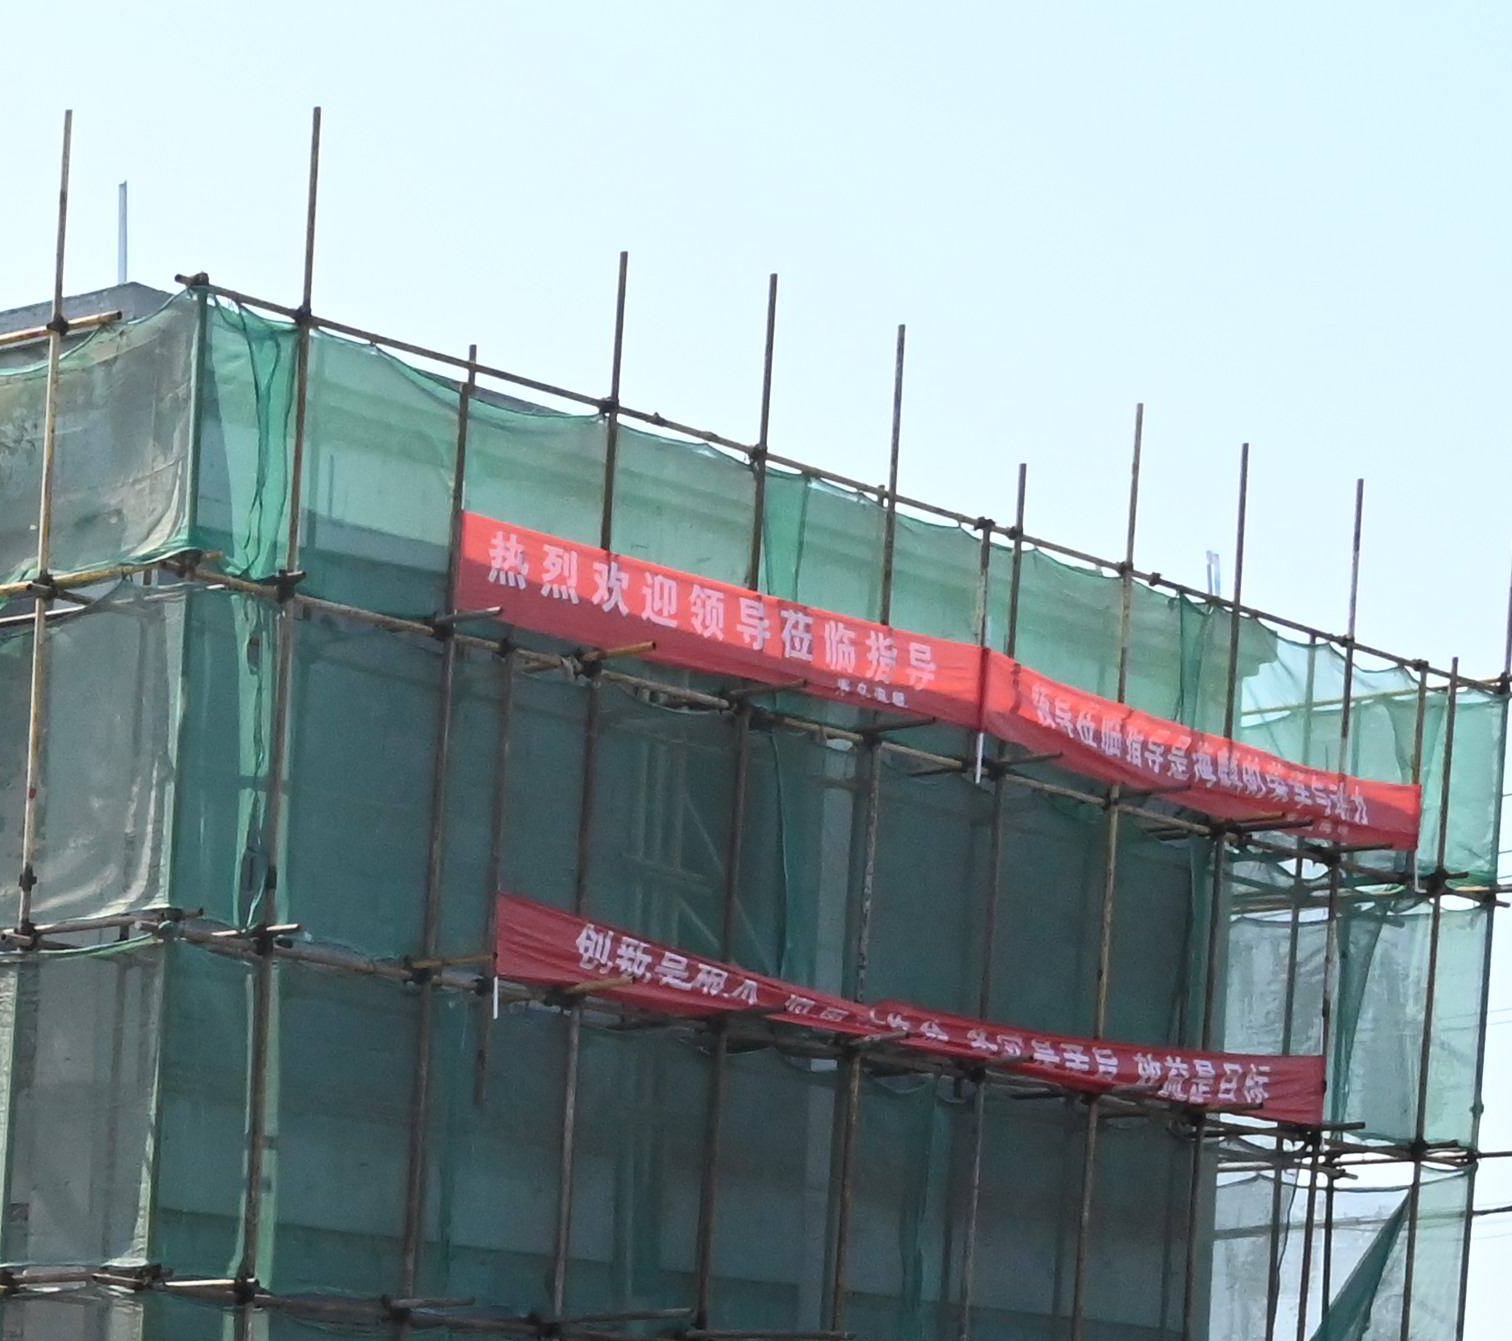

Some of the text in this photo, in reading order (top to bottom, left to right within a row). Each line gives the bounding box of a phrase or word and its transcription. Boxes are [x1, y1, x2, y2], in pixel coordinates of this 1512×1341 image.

[487, 530, 938, 691] 热烈欢迎领导莅临指导
